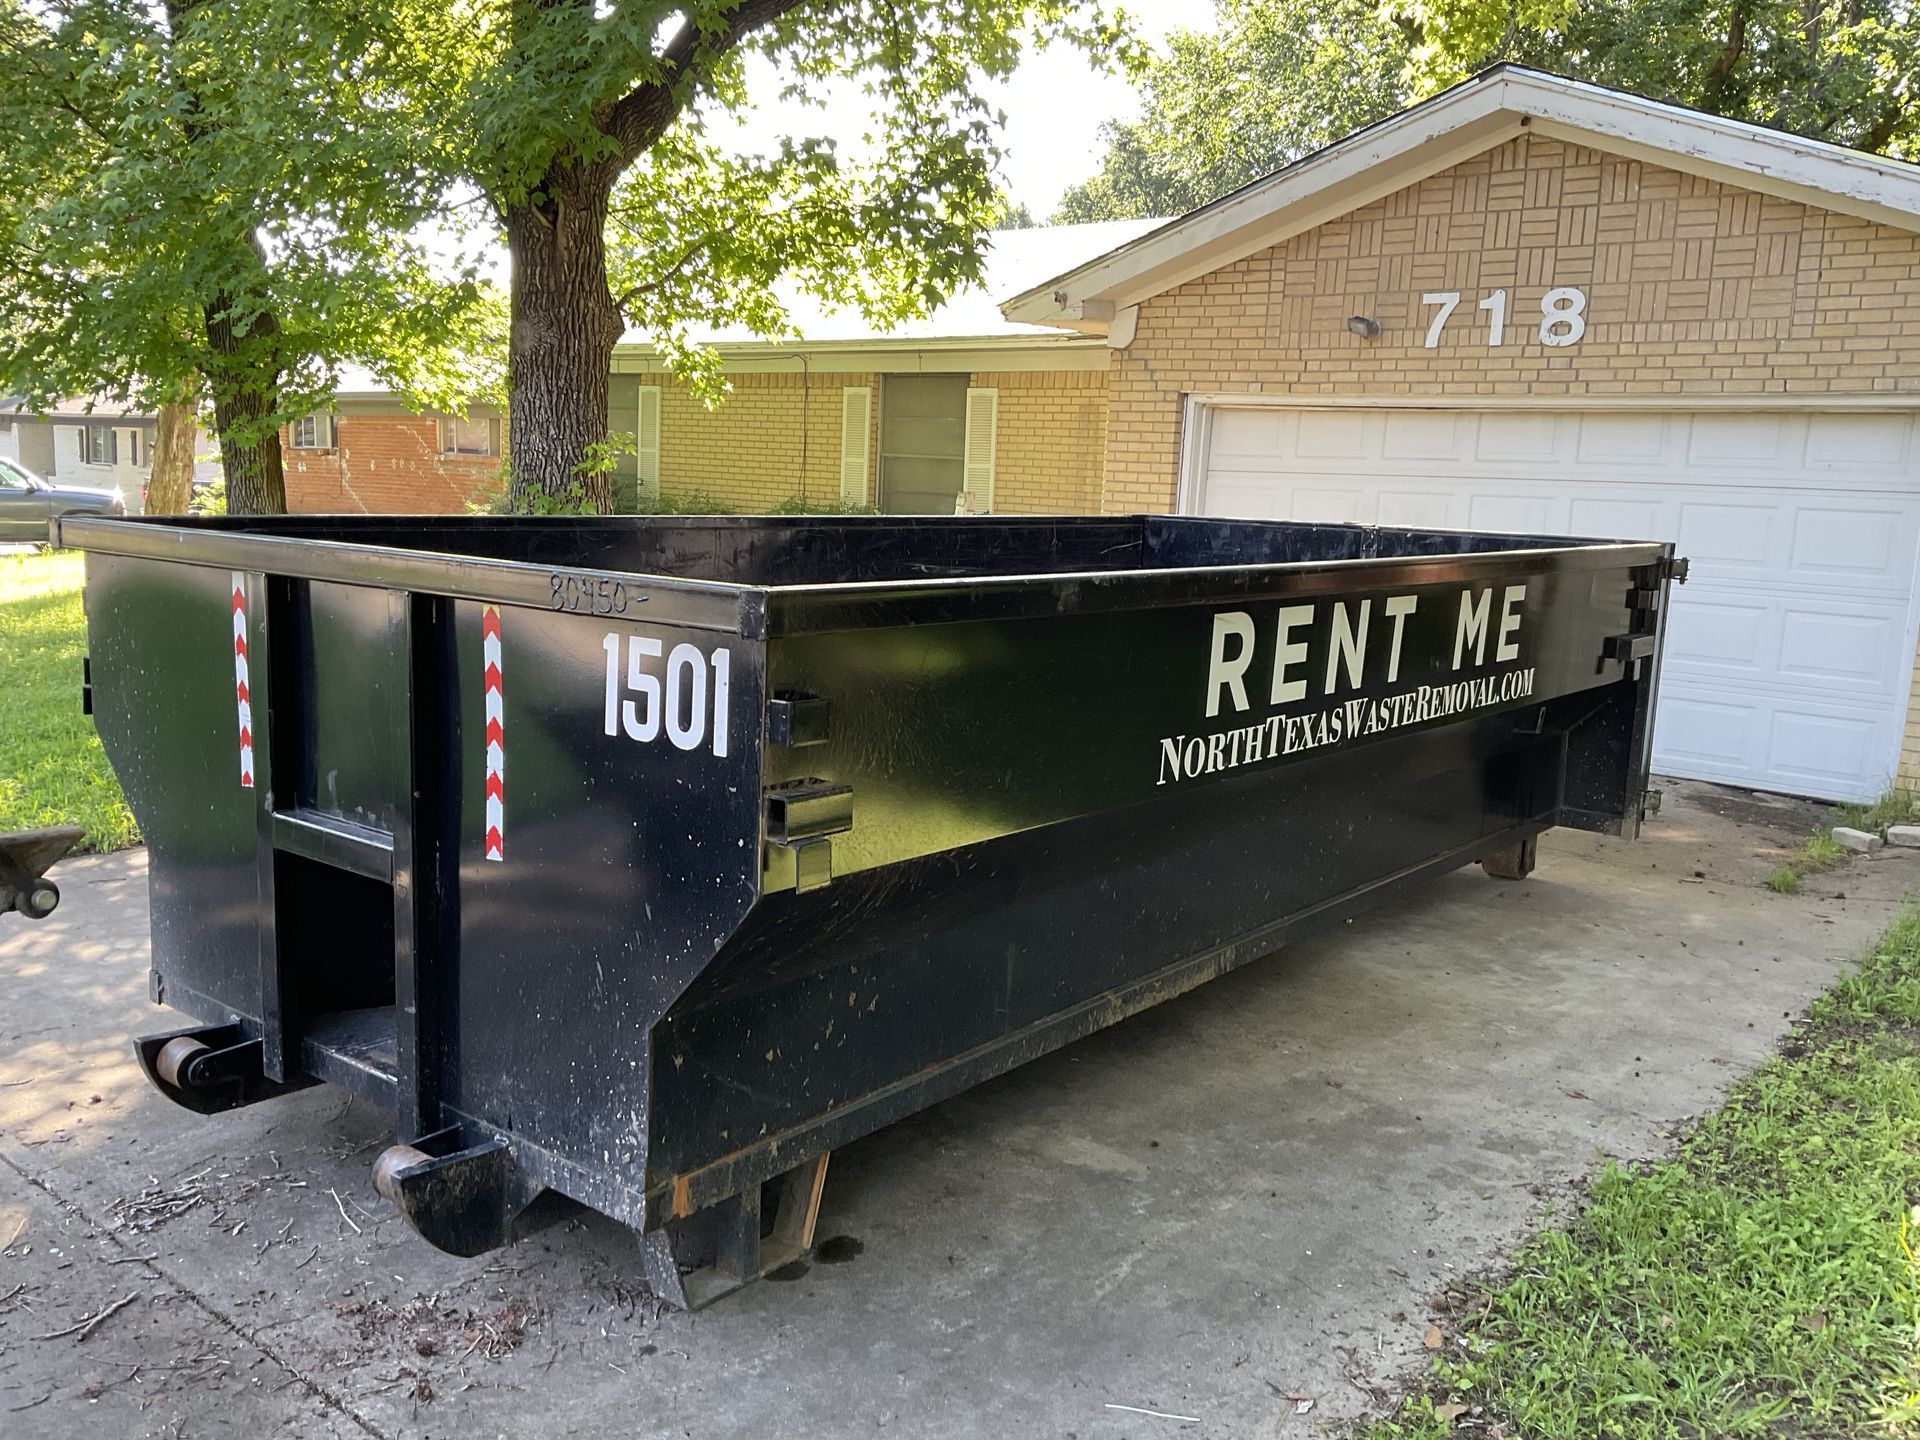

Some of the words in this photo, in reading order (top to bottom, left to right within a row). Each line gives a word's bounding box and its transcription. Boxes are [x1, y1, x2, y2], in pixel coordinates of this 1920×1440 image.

[1422, 287, 1586, 348] 718
[602, 632, 730, 758] 1501
[1205, 594, 1418, 718] RENT
[1451, 584, 1527, 671] ME
